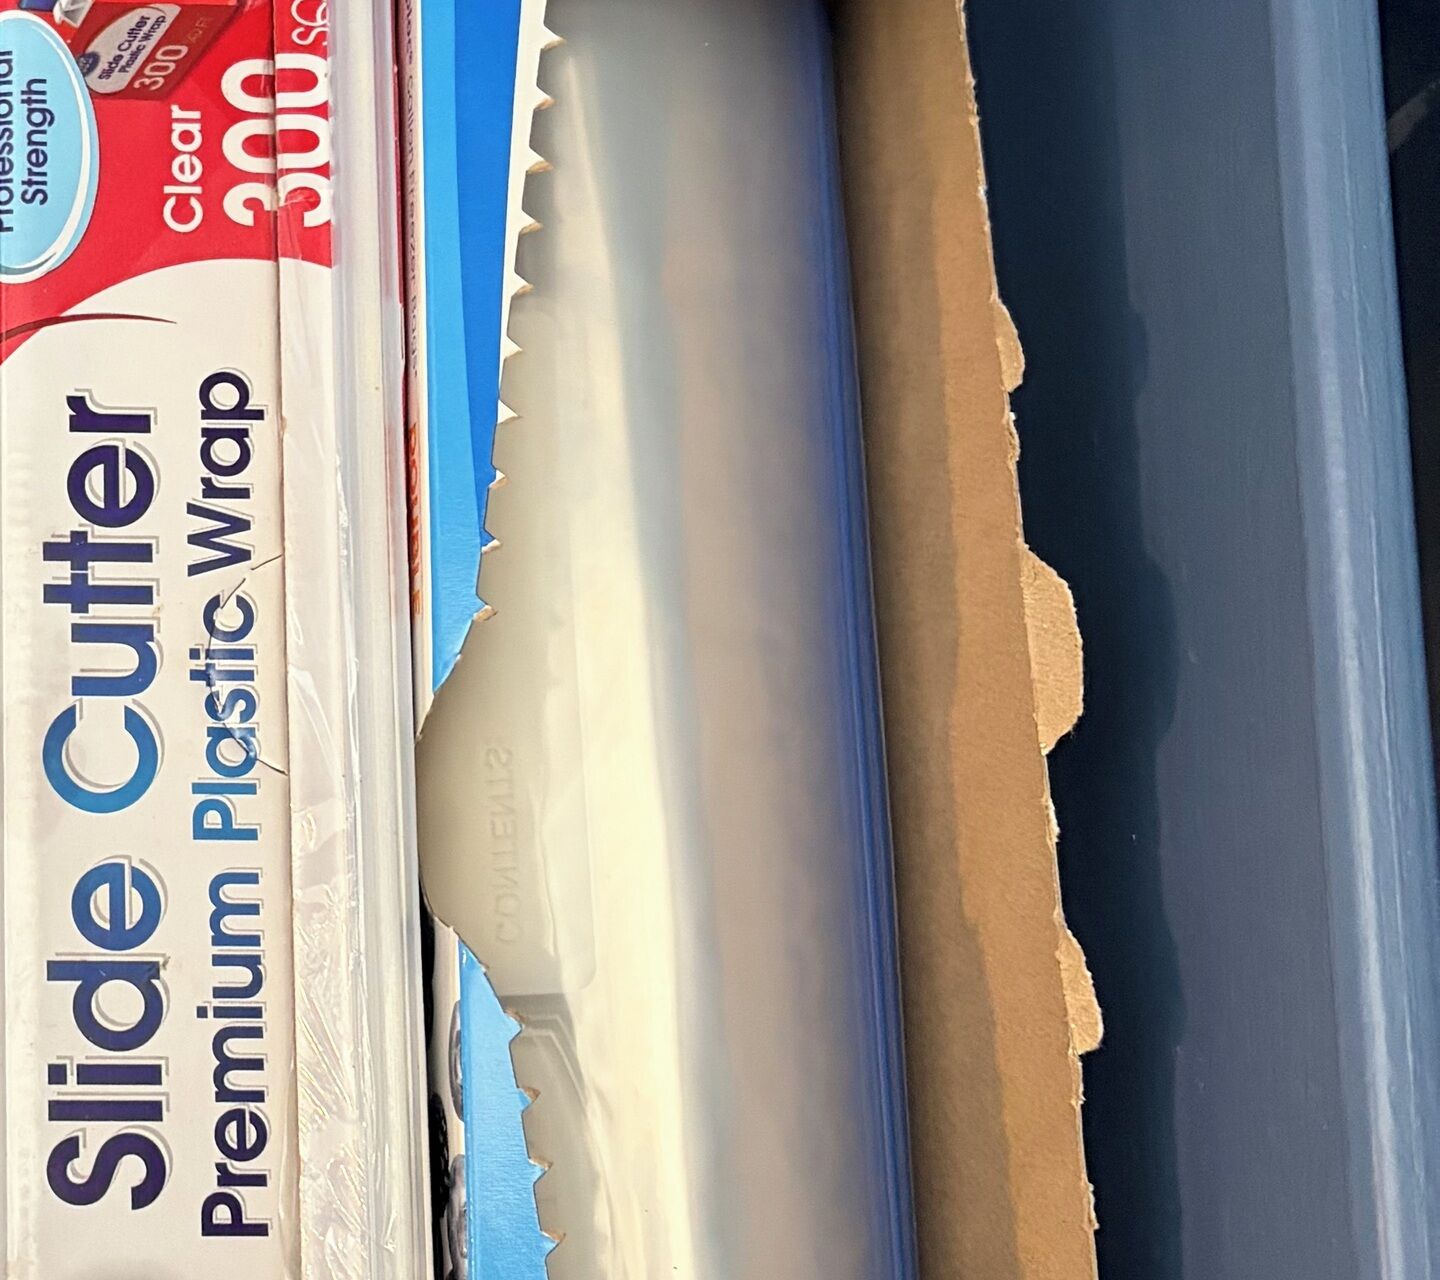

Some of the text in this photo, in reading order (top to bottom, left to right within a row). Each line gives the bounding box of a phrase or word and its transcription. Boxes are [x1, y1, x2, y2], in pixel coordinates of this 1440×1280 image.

[98, 16, 150, 80] Slide Cutter
[116, 15, 166, 74] Plastic Wrap
[132, 44, 188, 92] 300
[20, 78, 56, 206] Strength
[163, 104, 203, 233] Clear
[220, 52, 332, 227] 300
[42, 394, 166, 1210] Slide Cutter
[187, 371, 269, 1237] Premium Plastic Wrap
